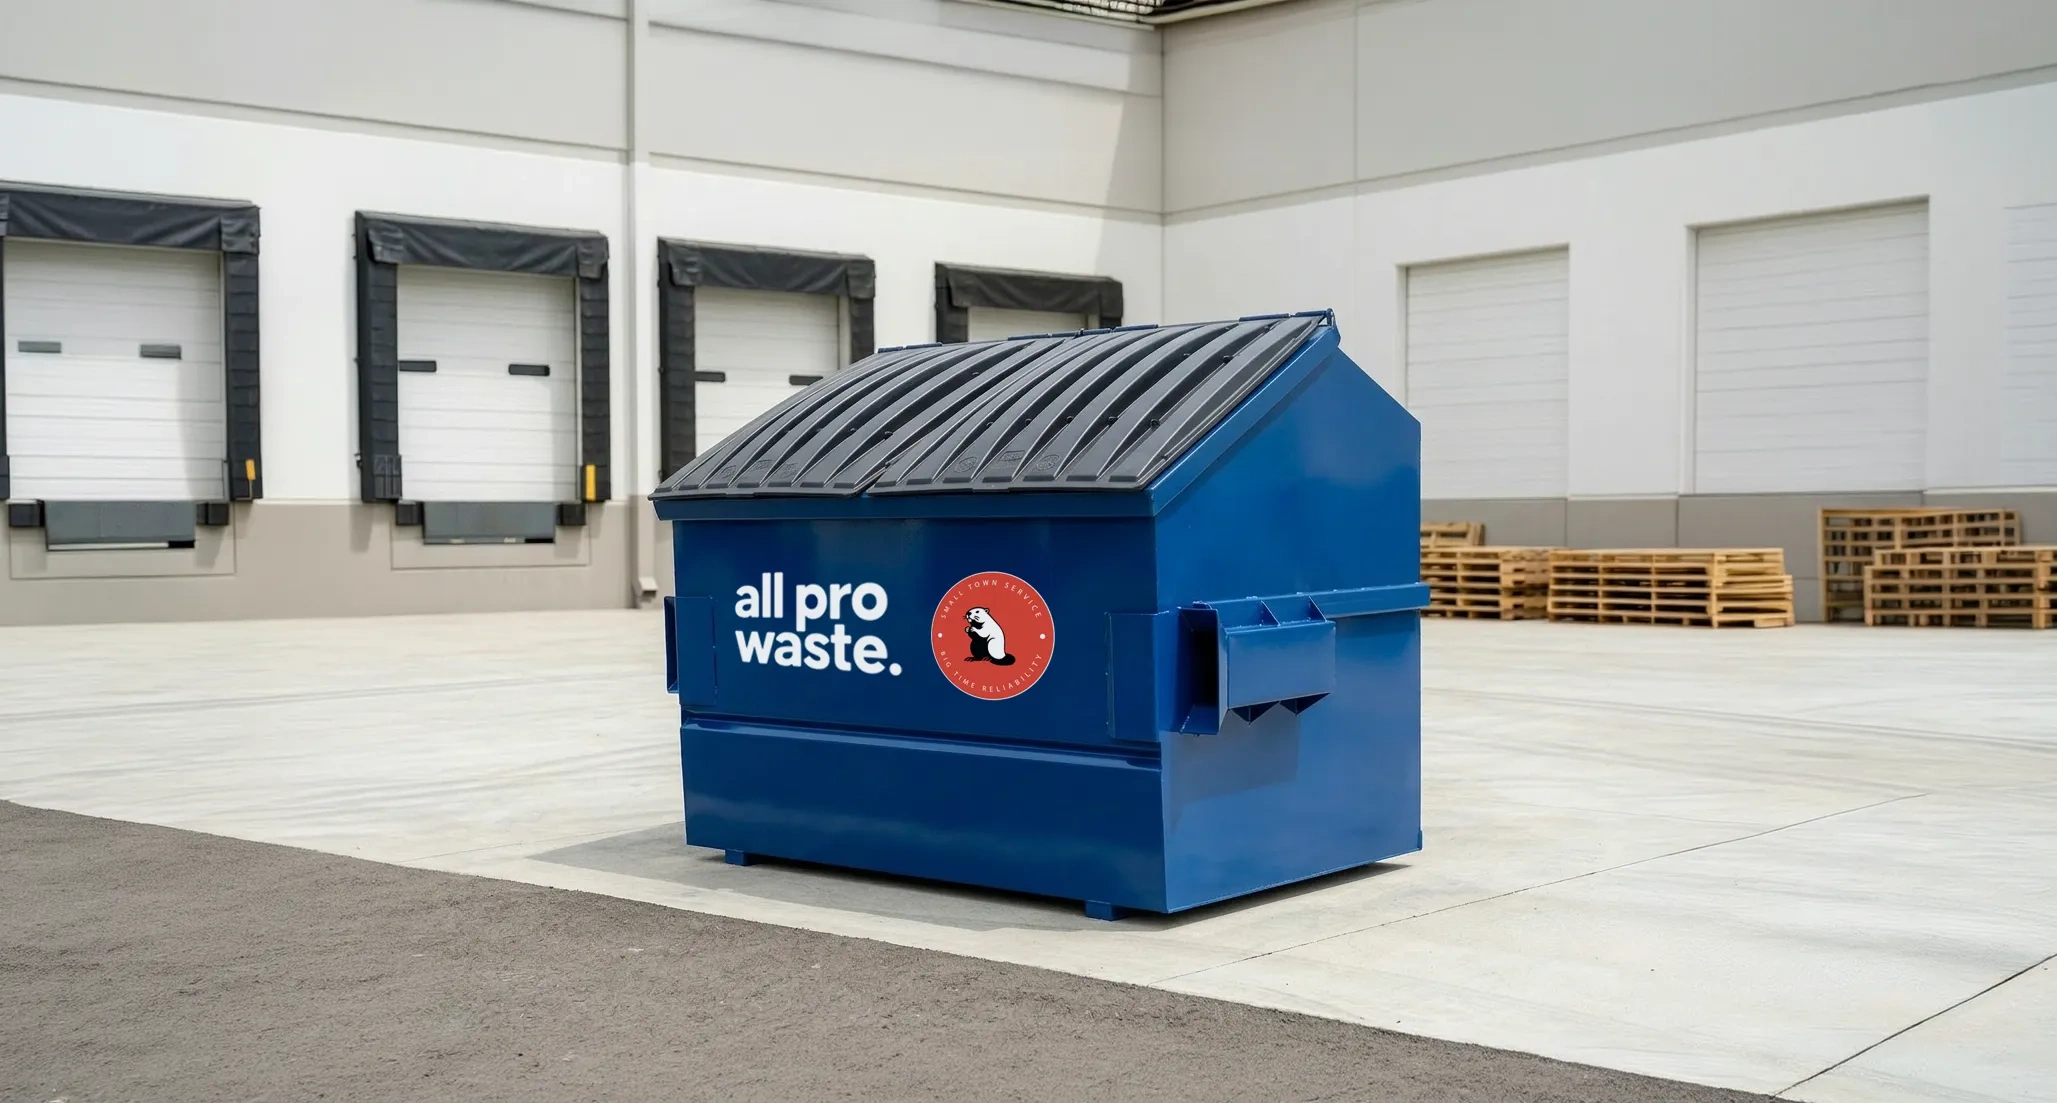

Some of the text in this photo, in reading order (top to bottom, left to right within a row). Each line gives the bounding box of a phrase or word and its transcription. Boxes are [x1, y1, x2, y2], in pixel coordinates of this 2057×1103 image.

[735, 572, 888, 632] all pro
[940, 579, 1042, 619] SMALL TOWN SERVICE
[736, 623, 902, 676] waste.
[940, 650, 1042, 693] BIG TIME RELIABILITY
